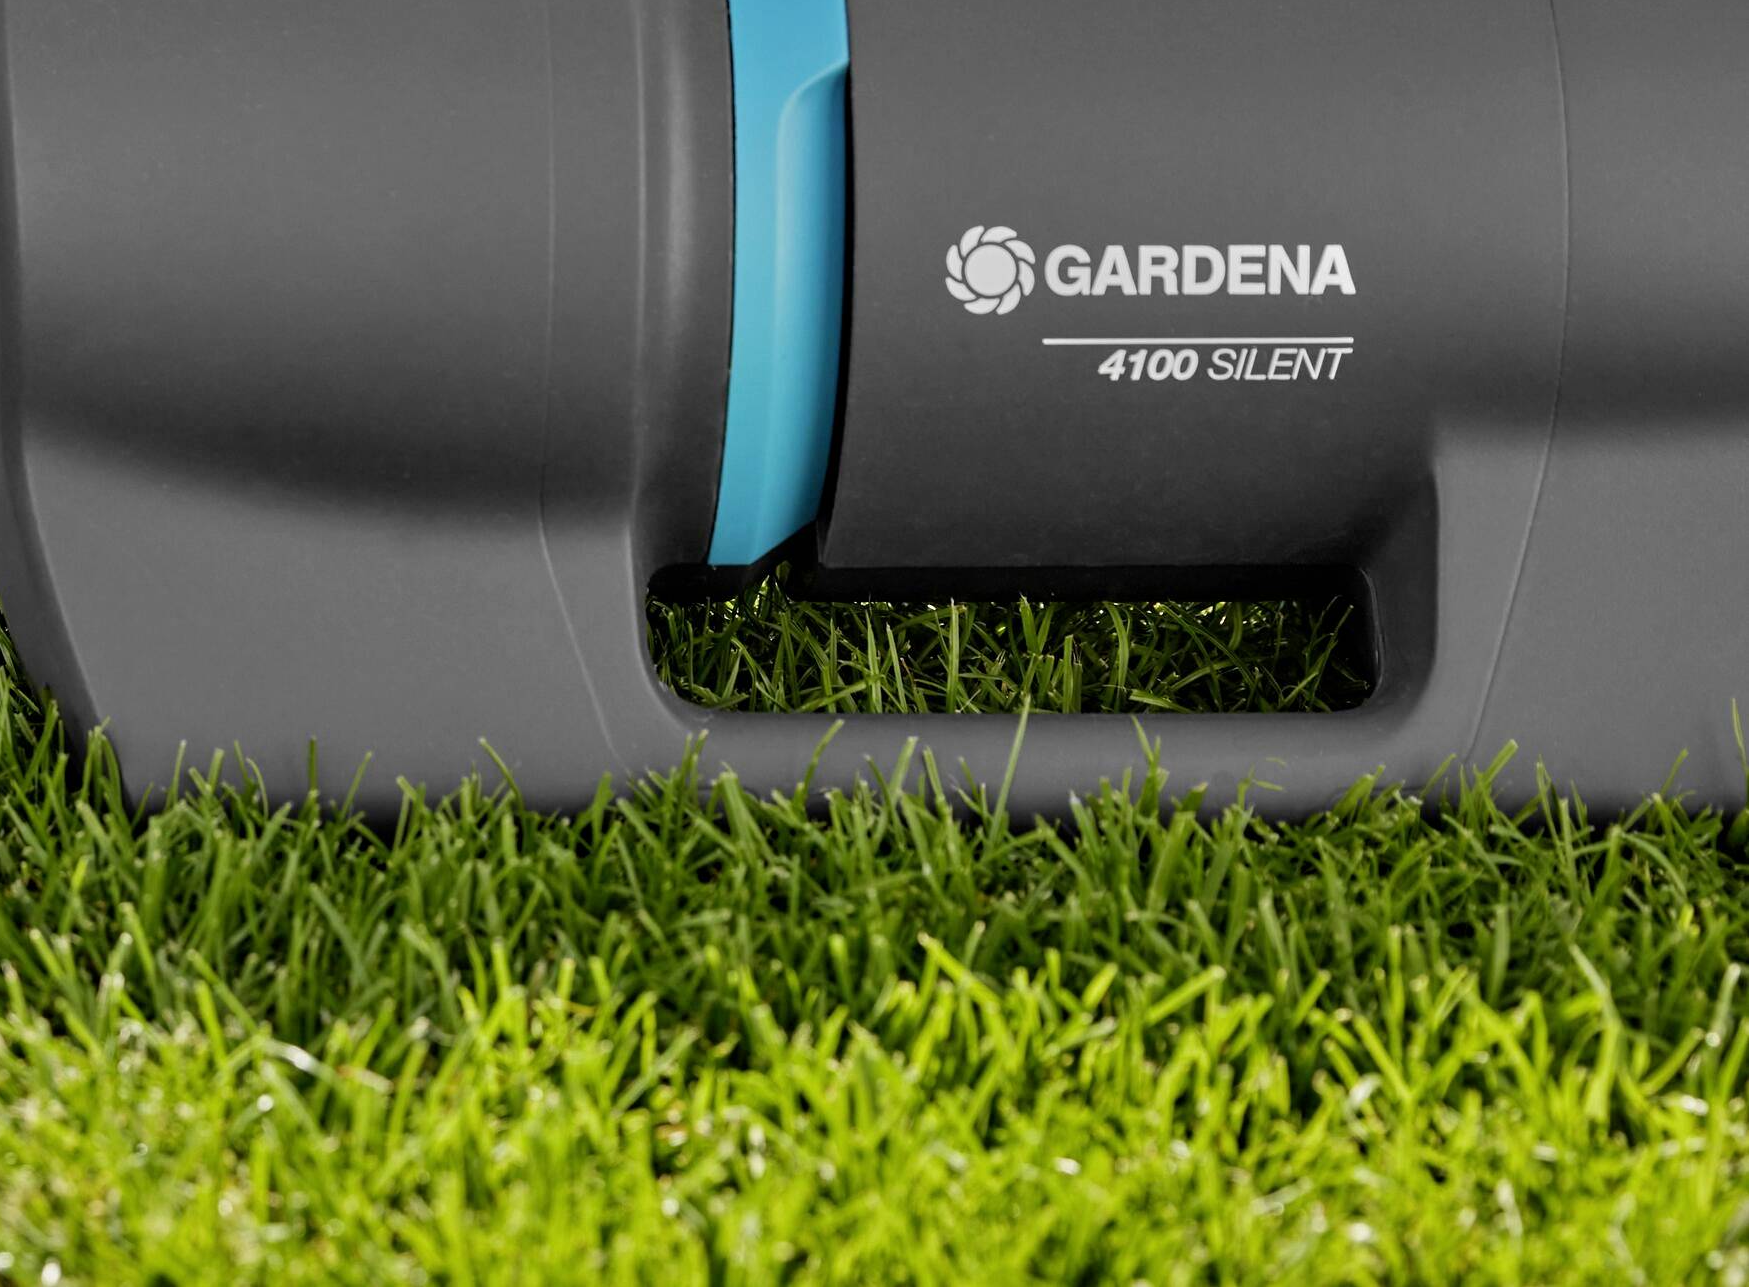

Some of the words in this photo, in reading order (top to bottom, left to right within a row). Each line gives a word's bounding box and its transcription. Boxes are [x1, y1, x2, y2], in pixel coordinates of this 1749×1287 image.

[1044, 244, 1357, 296] GARDENA
[1098, 348, 1199, 381] 4100
[1207, 347, 1353, 380] SILENT
